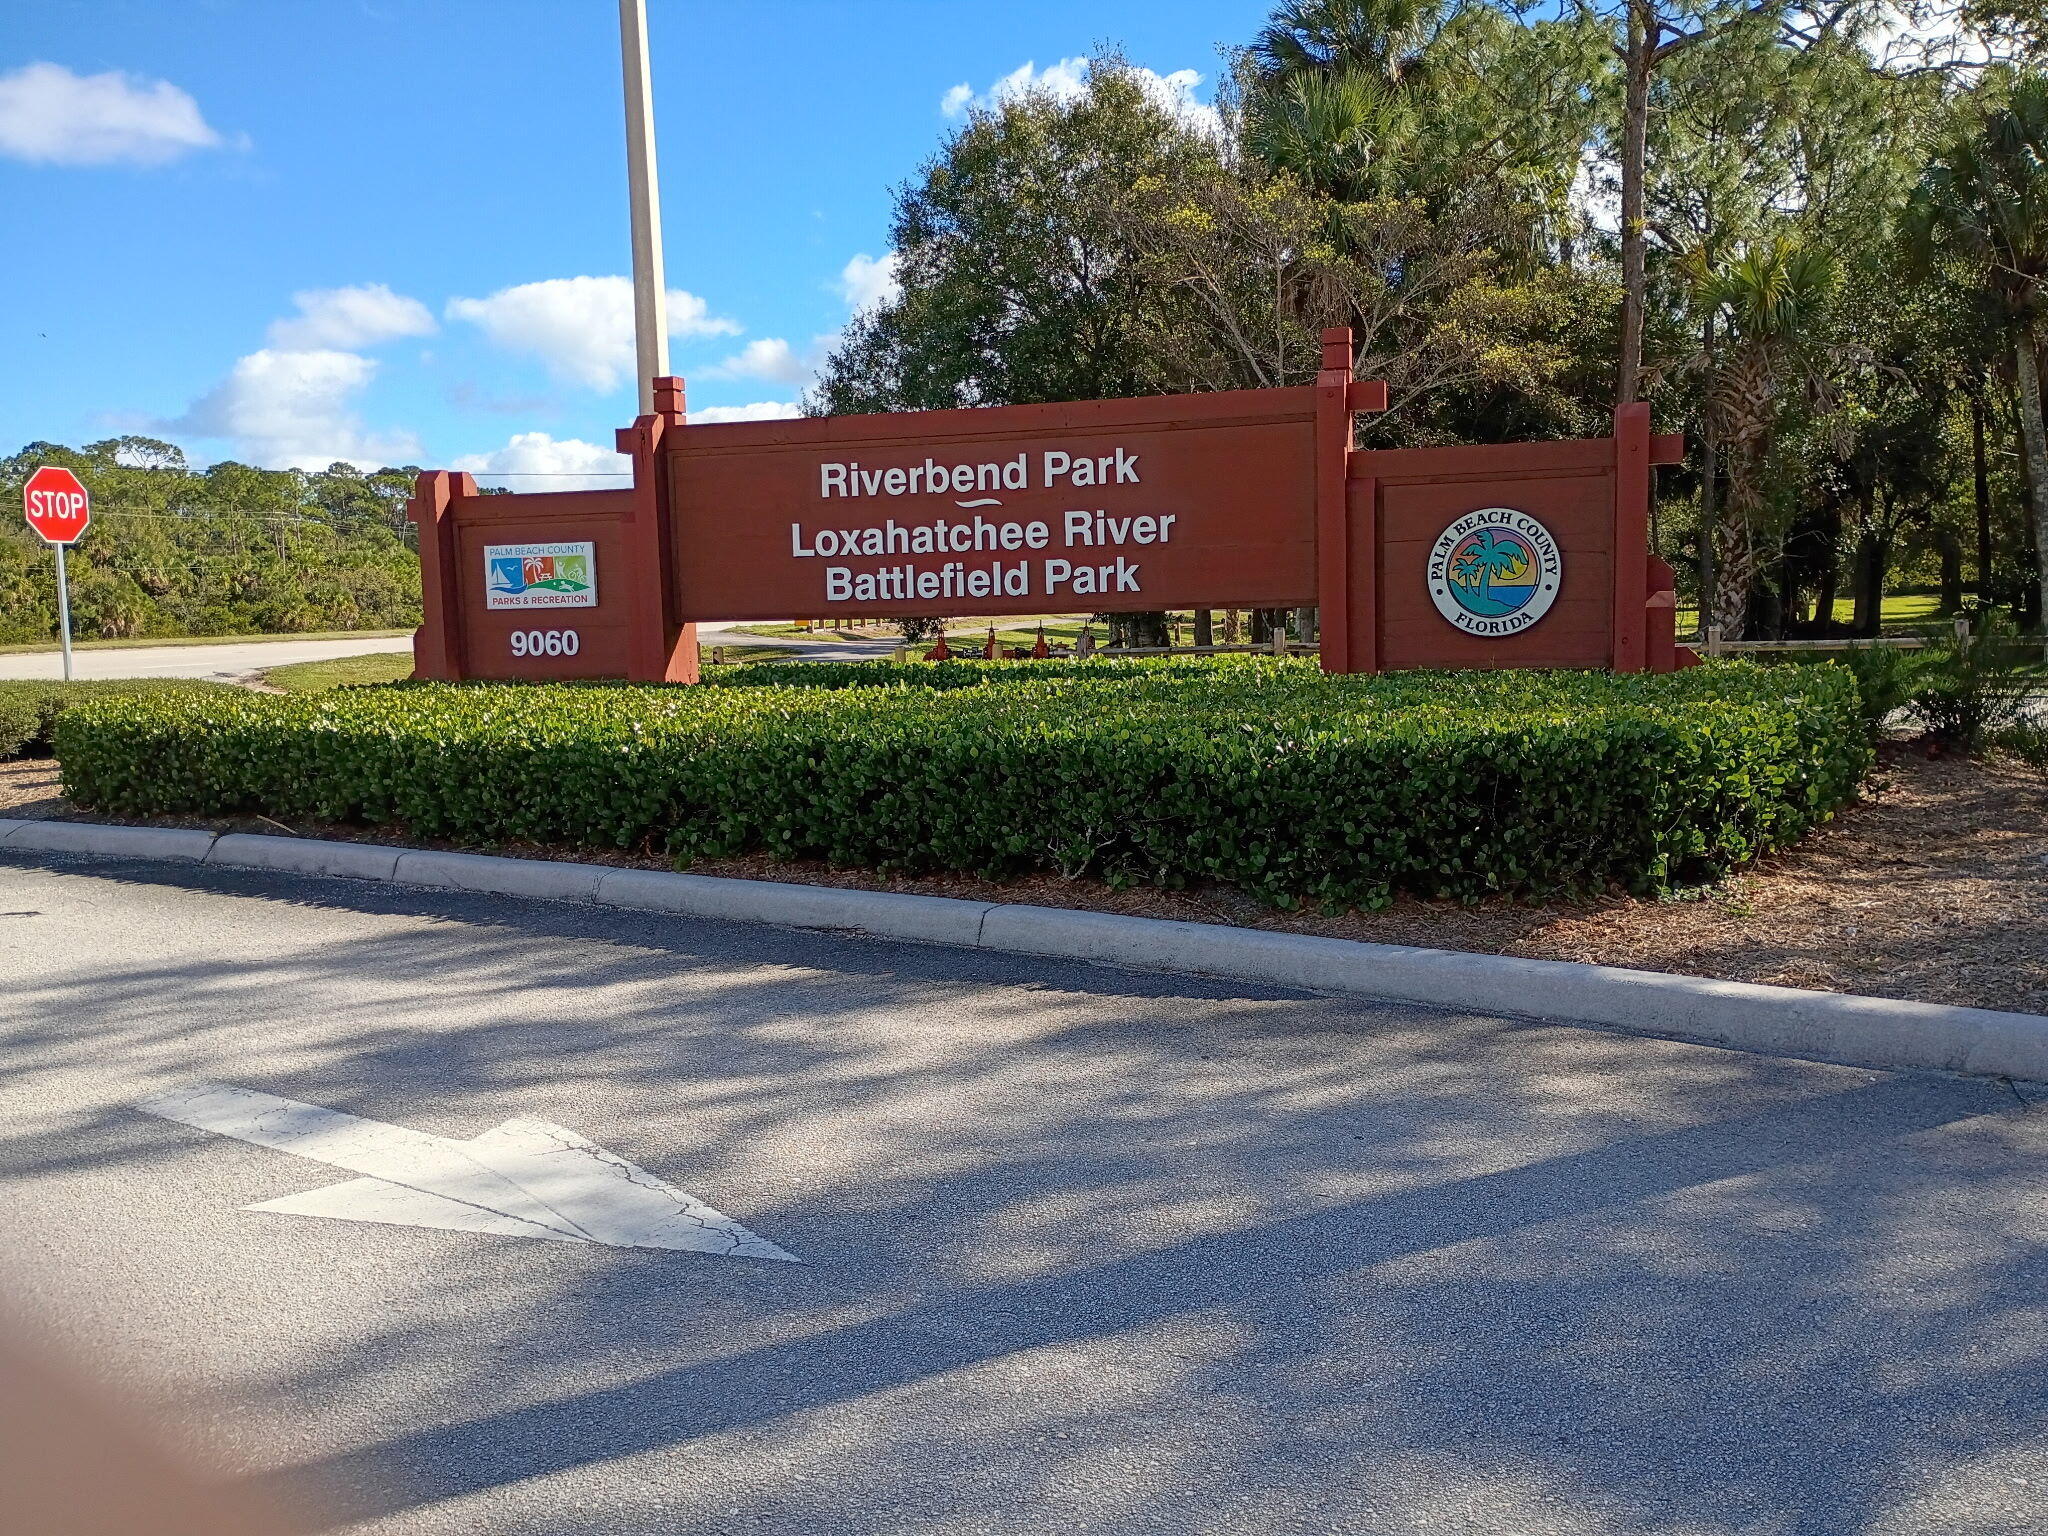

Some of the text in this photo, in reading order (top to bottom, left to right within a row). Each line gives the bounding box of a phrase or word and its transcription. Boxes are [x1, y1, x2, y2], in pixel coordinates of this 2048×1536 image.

[820, 447, 1140, 498] Riverbend Park
[30, 490, 84, 519] STOP
[791, 509, 1176, 557] Loxahatchee River
[1431, 511, 1557, 580] PALM BEACH COUNTY
[489, 545, 585, 556] PALM BEACH COUNTY
[826, 556, 1141, 601] Battlefield Park
[492, 595, 588, 605] PARKS & RECREATION
[1454, 611, 1534, 633] FLORIDA
[510, 629, 579, 656] 9060
